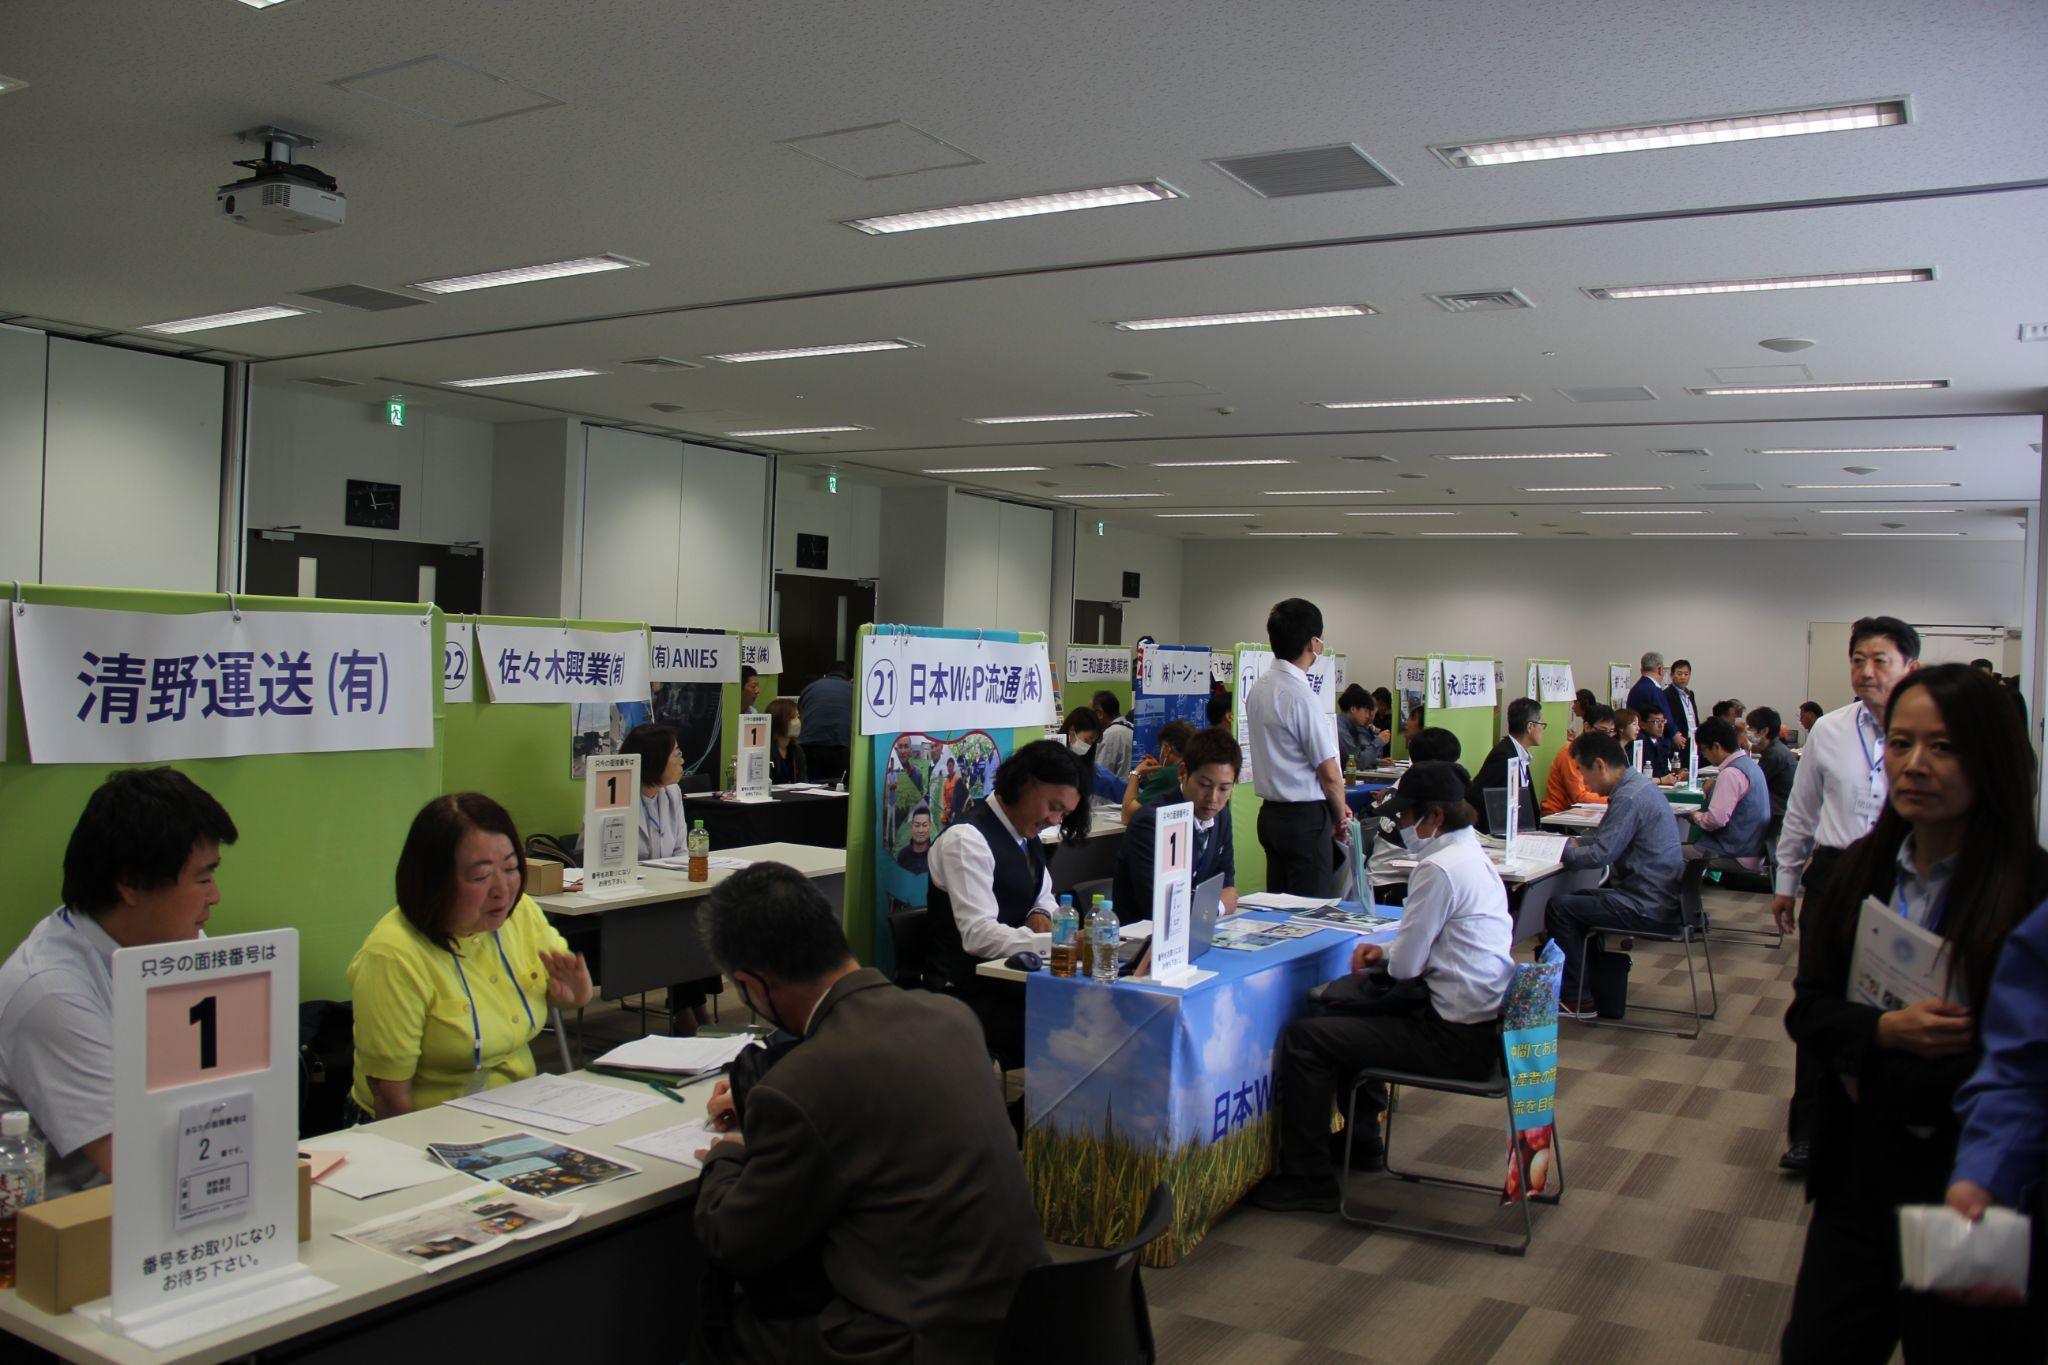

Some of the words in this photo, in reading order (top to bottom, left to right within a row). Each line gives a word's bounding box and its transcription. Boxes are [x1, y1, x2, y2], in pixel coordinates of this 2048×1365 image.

[499, 648, 625, 687] 佐々木興業(有)
[77, 649, 389, 724] 清野運送(有)
[750, 727, 757, 746] 1
[607, 776, 617, 805] 1
[1170, 831, 1177, 867] 1
[141, 944, 277, 978] 只今の面接番号は
[189, 995, 217, 1070] 1
[199, 1137, 210, 1161] 2
[142, 1223, 277, 1276] 番号をお取りになり
[162, 1254, 259, 1292] お待ち下さい。
